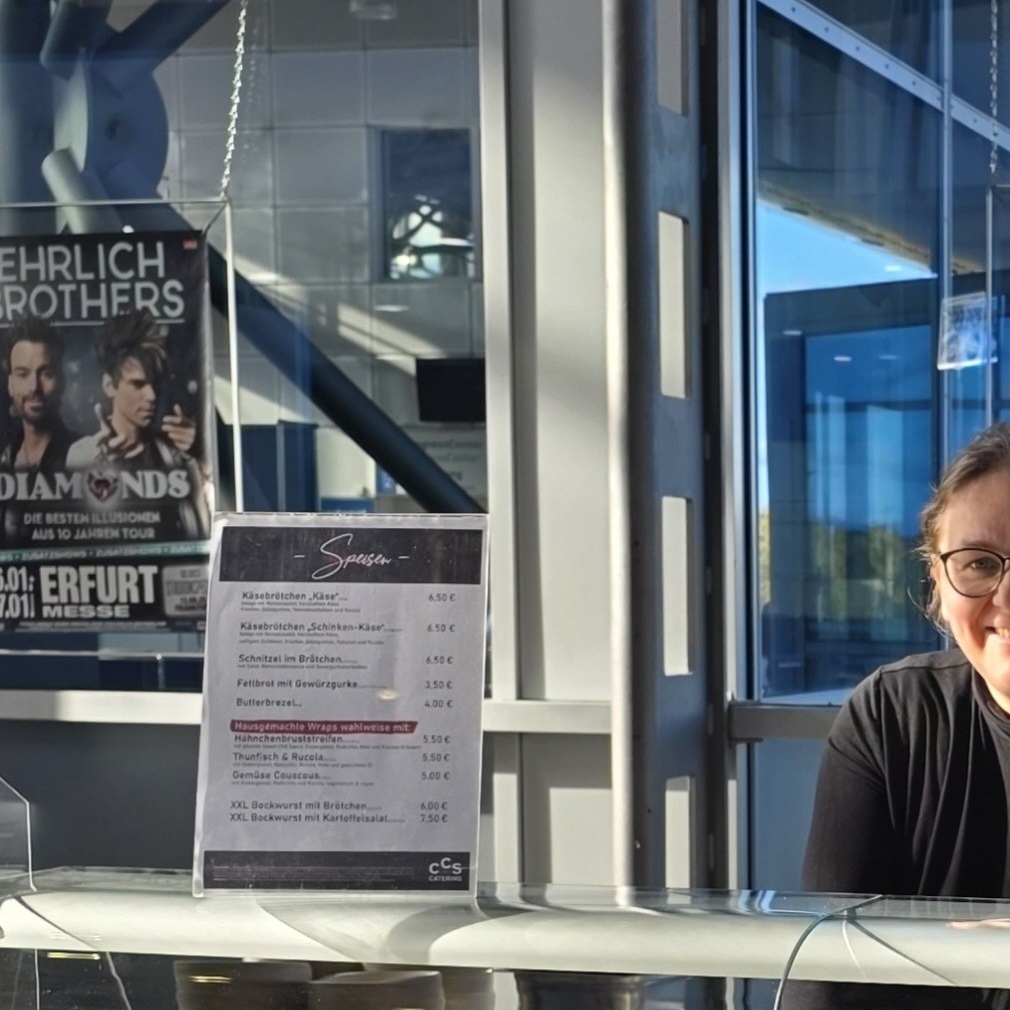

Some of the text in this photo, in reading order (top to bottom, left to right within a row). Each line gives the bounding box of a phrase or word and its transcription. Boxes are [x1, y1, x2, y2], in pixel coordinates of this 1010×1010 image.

[0, 241, 165, 282] EHRLICH
[0, 279, 185, 321] ROTHERS
[24, 511, 161, 525] DIE BESTEN ILLUSIONEN
[32, 528, 55, 541] AUS
[57, 528, 71, 540] 10
[122, 527, 155, 540] TOUR
[311, 532, 393, 581] Speisen
[39, 565, 158, 604] ERFURT
[242, 591, 307, 601] Käsebrötchen
[428, 593, 448, 602] 6,50
[449, 593, 456, 602] €
[42, 604, 130, 619] MESSE
[240, 622, 305, 632] Käsebrötchen
[427, 624, 447, 633] 6,50
[449, 624, 456, 633] €
[239, 654, 453, 665] Schnitzel im Brötchen 6,50 €
[237, 678, 275, 688] Fettbrot
[277, 679, 293, 688] mit
[295, 678, 358, 690] Gewürzgurke
[446, 680, 453, 689] €
[236, 698, 453, 708] Butterbrezel 4,00 €
[234, 721, 306, 733] Hausgemachte
[307, 722, 338, 732] Wraps
[340, 722, 391, 732] wahlweise
[234, 734, 451, 744] Hähnchenbruststreifen 5,50 €
[233, 752, 450, 762] Thunfisch & Rucola 5,50 €
[232, 770, 450, 780] Gemüse Couscous 5,00 €
[230, 800, 448, 811] XXL Bockwurst mit Brötchen 6,00 €
[229, 813, 448, 823] XXL Bockwurst mit Kartoffelsalat 7,50 €
[428, 857, 462, 875] CCS
